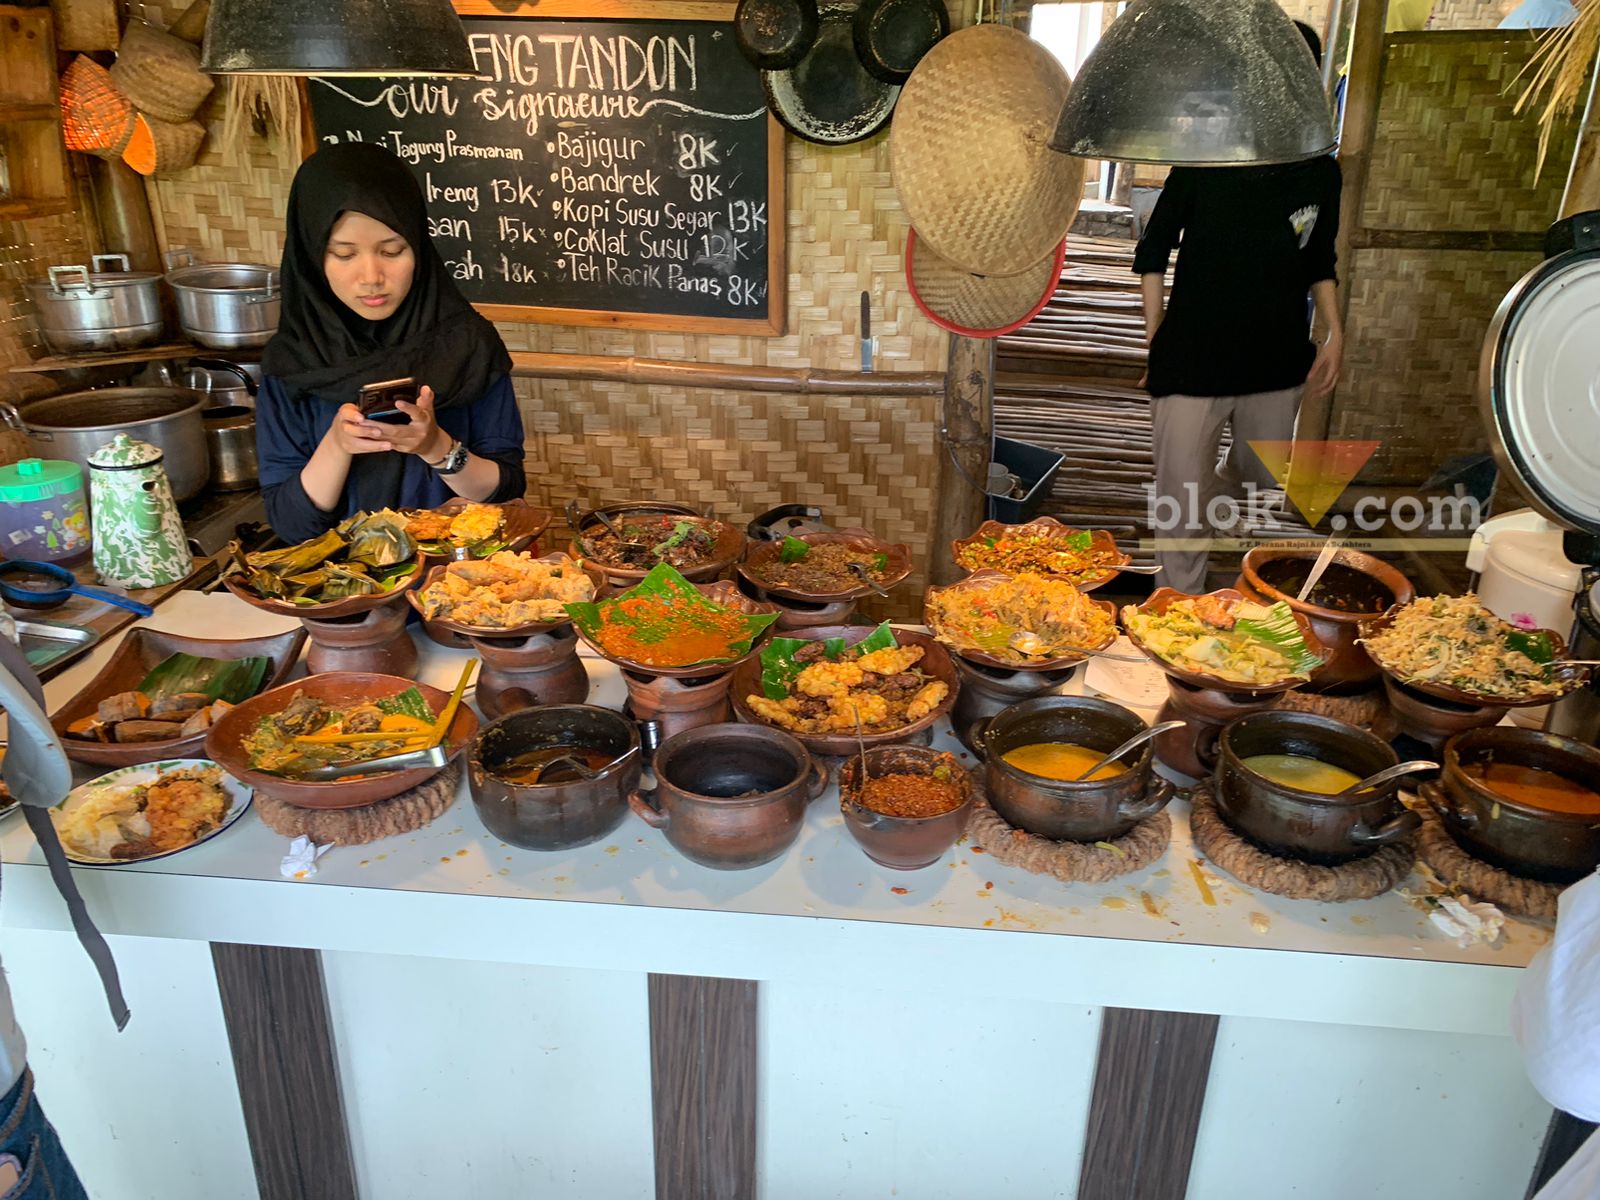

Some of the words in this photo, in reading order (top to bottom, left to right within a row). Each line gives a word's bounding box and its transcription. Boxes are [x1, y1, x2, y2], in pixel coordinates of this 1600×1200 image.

[538, 34, 697, 92] TANDON
[446, 129, 524, 161] Prasmanan
[557, 131, 646, 168] Bajigur
[561, 163, 661, 197] Bandrek
[563, 197, 610, 229] Kopi
[615, 198, 660, 228] Susu
[664, 202, 722, 237] Segar
[639, 230, 689, 261] Susu
[562, 251, 600, 282] Teh
[668, 263, 722, 296] Panas
